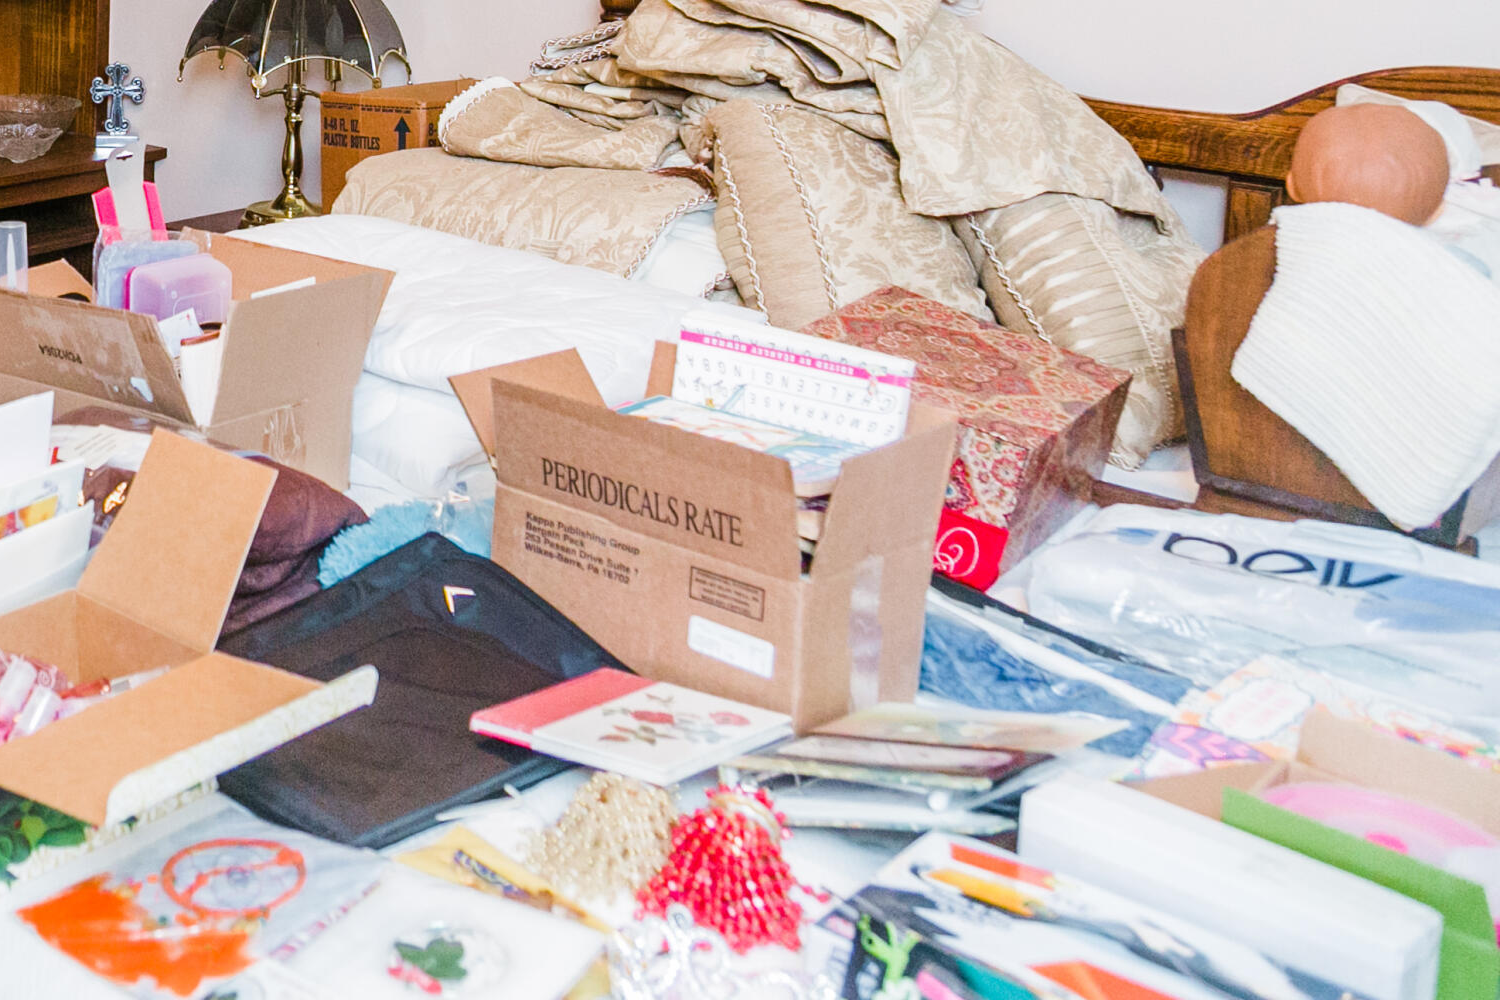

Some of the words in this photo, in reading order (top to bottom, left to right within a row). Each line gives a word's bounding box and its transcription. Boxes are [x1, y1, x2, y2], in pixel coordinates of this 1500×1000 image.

[323, 132, 348, 147] PLASTIC
[349, 135, 380, 150] BOTTLES
[541, 457, 680, 527] PERIODICALS
[684, 501, 743, 547] RATE
[525, 521, 560, 540] Bargain
[563, 533, 585, 547] Pack
[526, 511, 555, 528] Kappa
[557, 521, 607, 545] Publishing
[609, 539, 640, 555] Group
[579, 549, 604, 565] Drive
[606, 558, 631, 573] Suite
